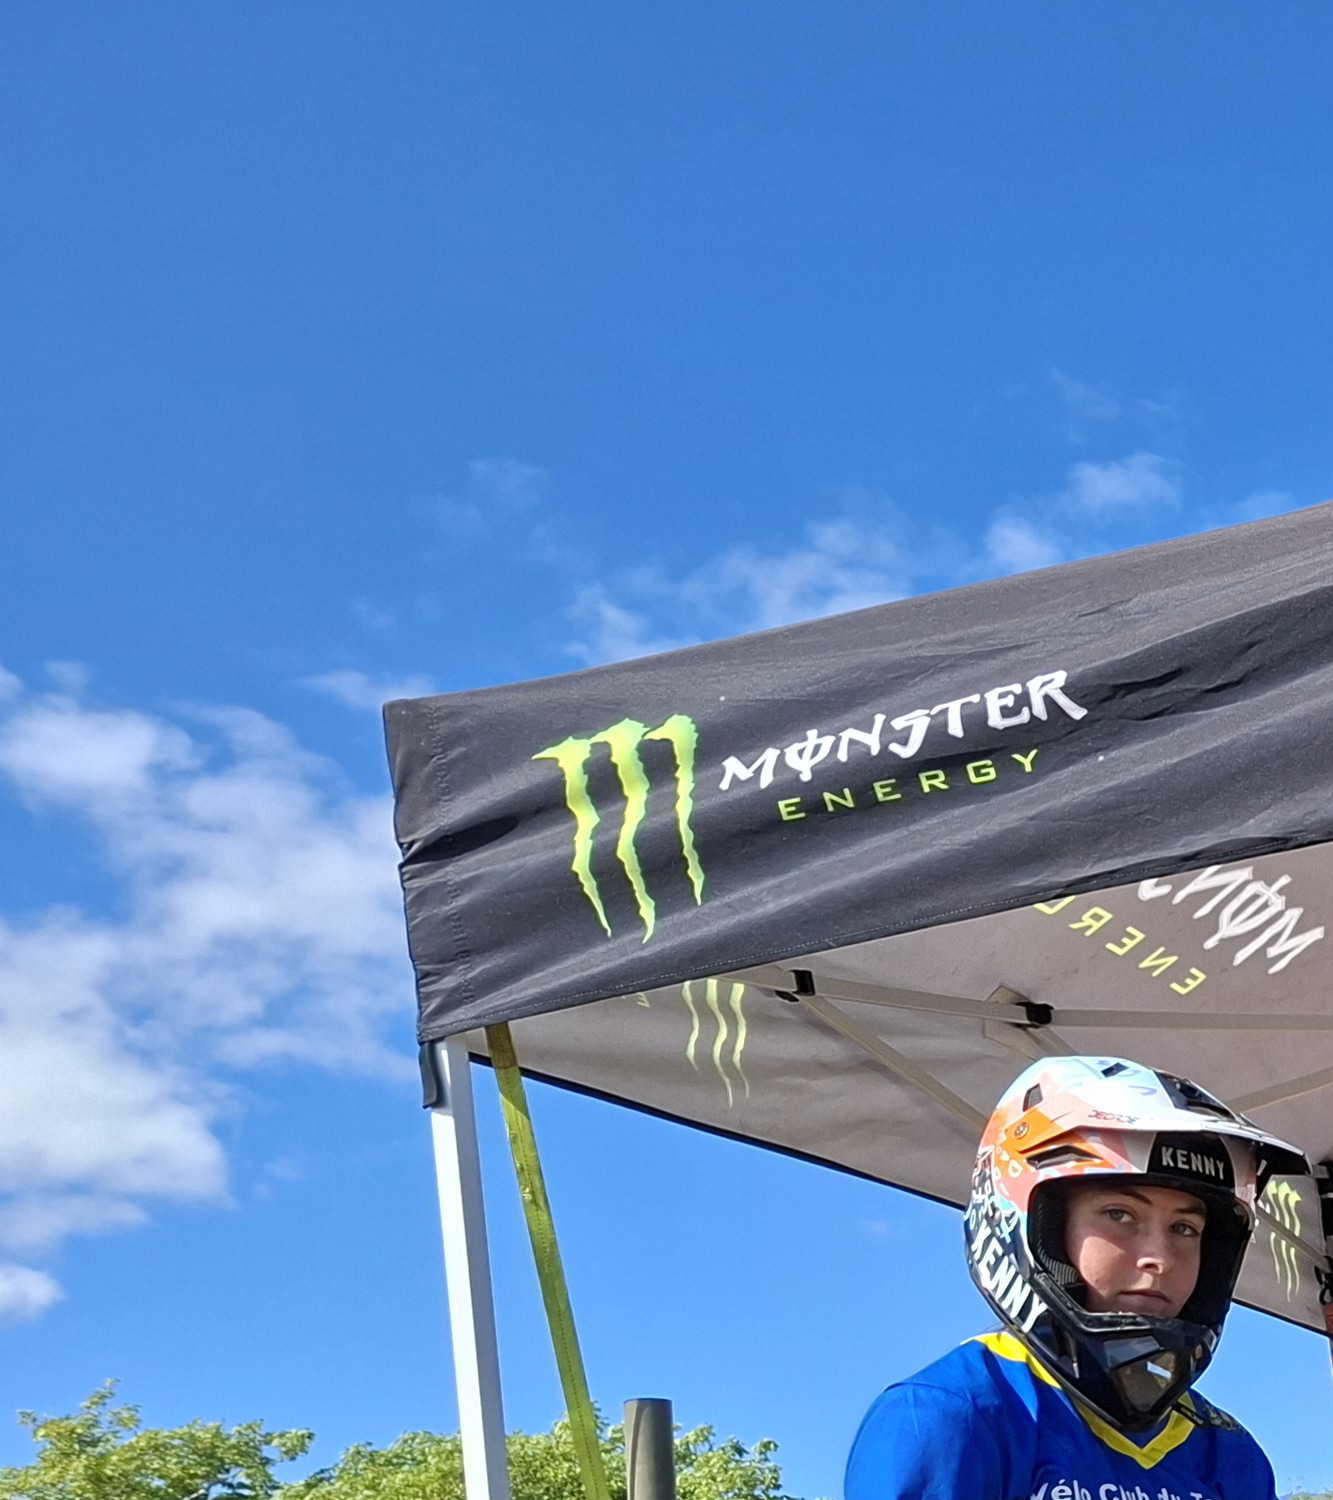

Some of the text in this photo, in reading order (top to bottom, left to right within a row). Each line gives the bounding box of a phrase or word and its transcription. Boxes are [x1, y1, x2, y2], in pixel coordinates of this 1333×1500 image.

[718, 669, 1088, 792] MONSTER
[776, 748, 1042, 823] ENERGY
[1160, 1146, 1225, 1181] KENNY
[971, 1219, 1048, 1333] KENNY
